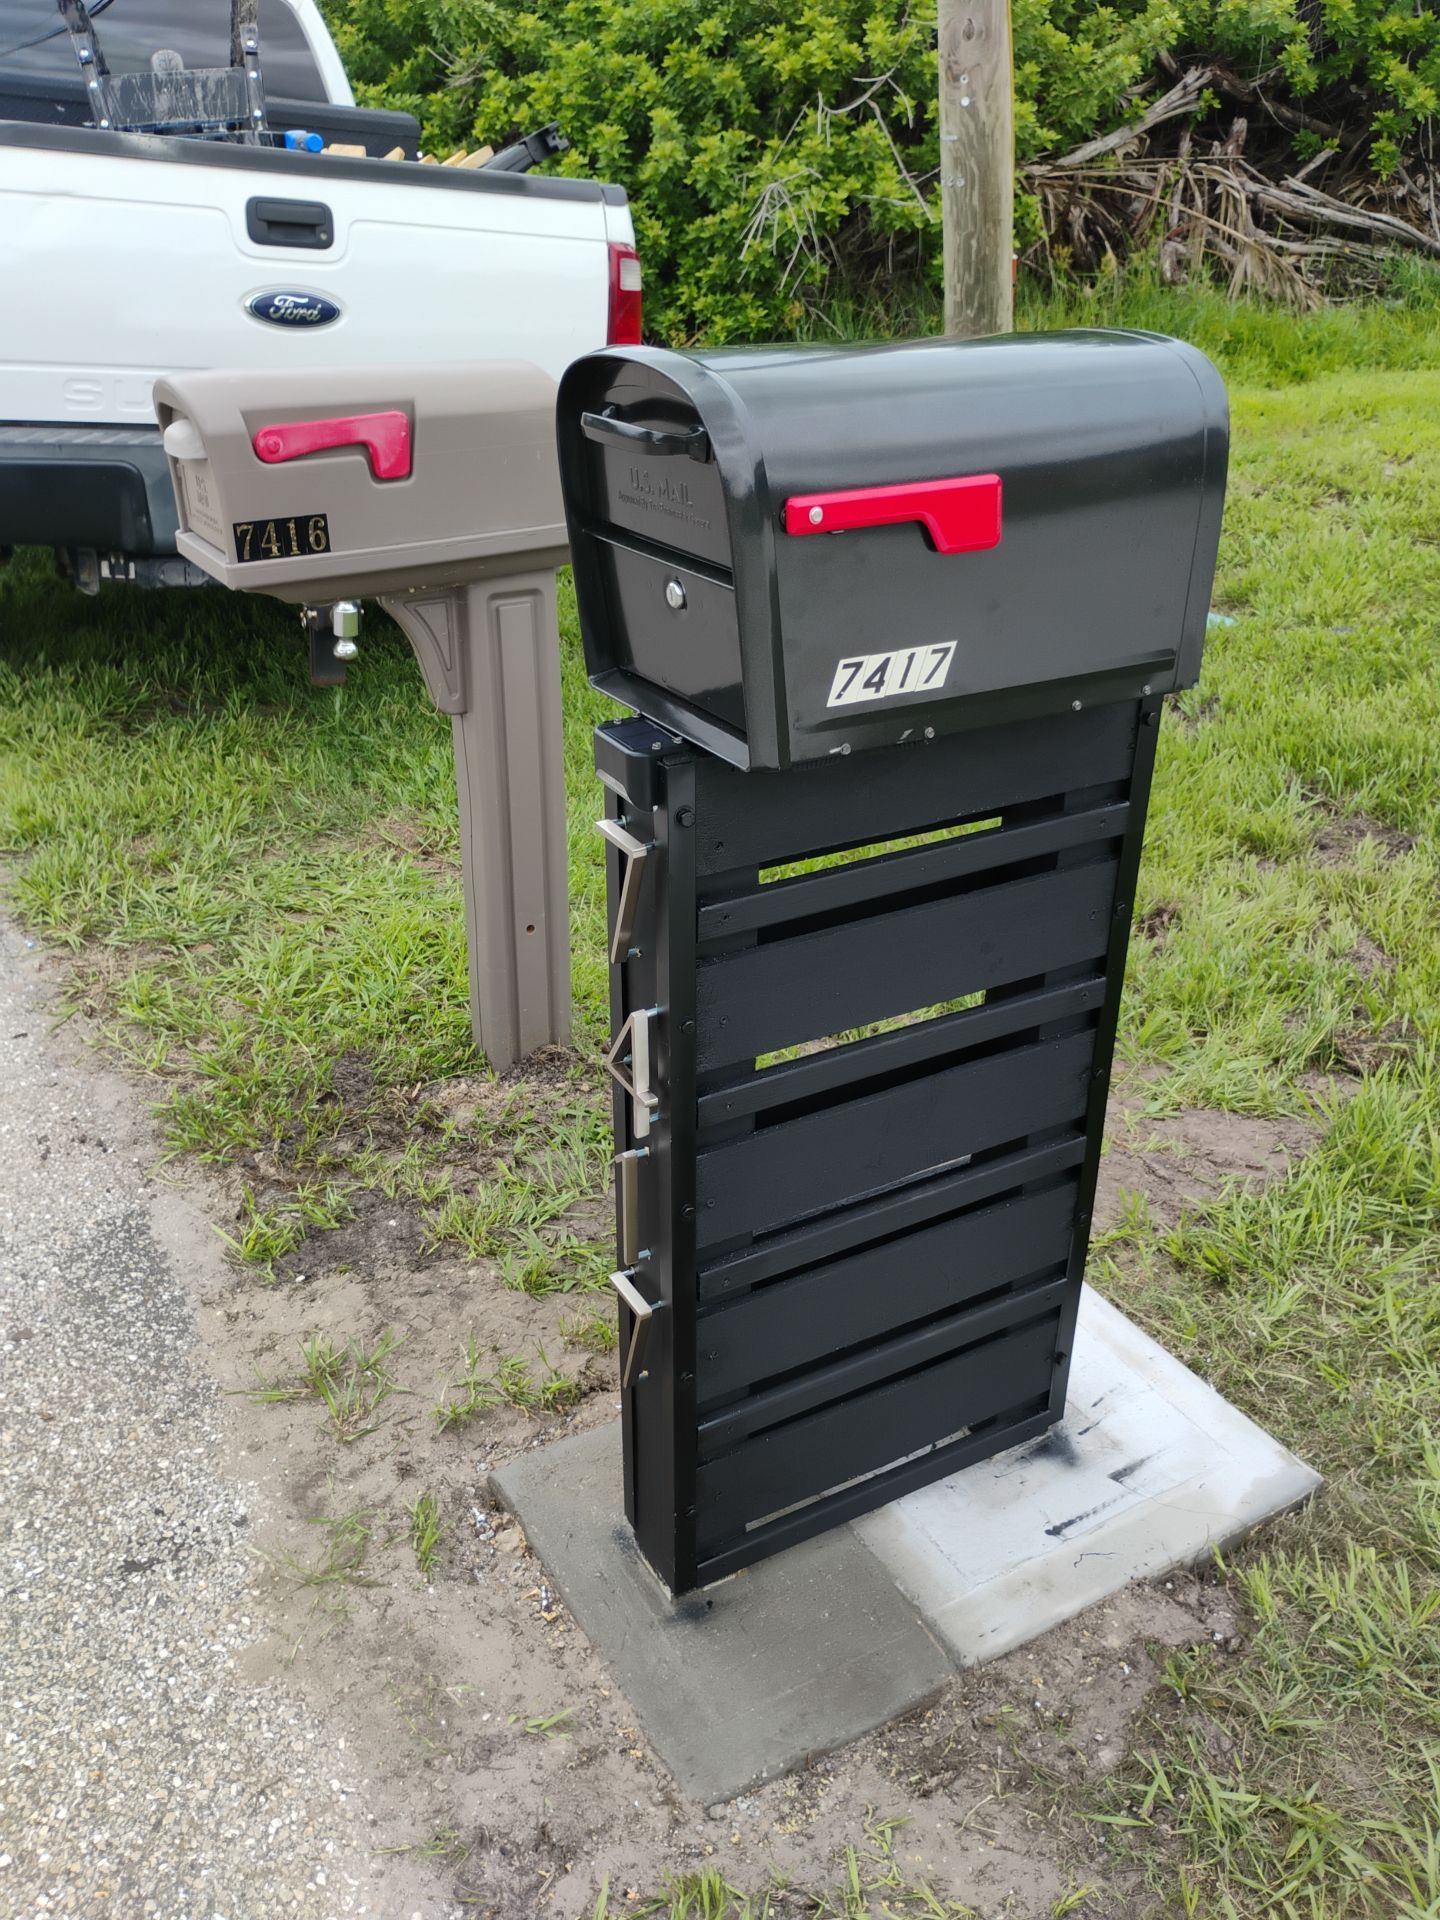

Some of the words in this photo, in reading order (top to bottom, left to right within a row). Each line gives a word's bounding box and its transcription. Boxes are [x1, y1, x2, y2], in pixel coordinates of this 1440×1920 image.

[269, 295, 322, 321] Ford
[63, 378, 155, 412] SU
[658, 477, 694, 508] MAIL
[236, 516, 327, 560] 7416
[834, 646, 952, 700] 7417
